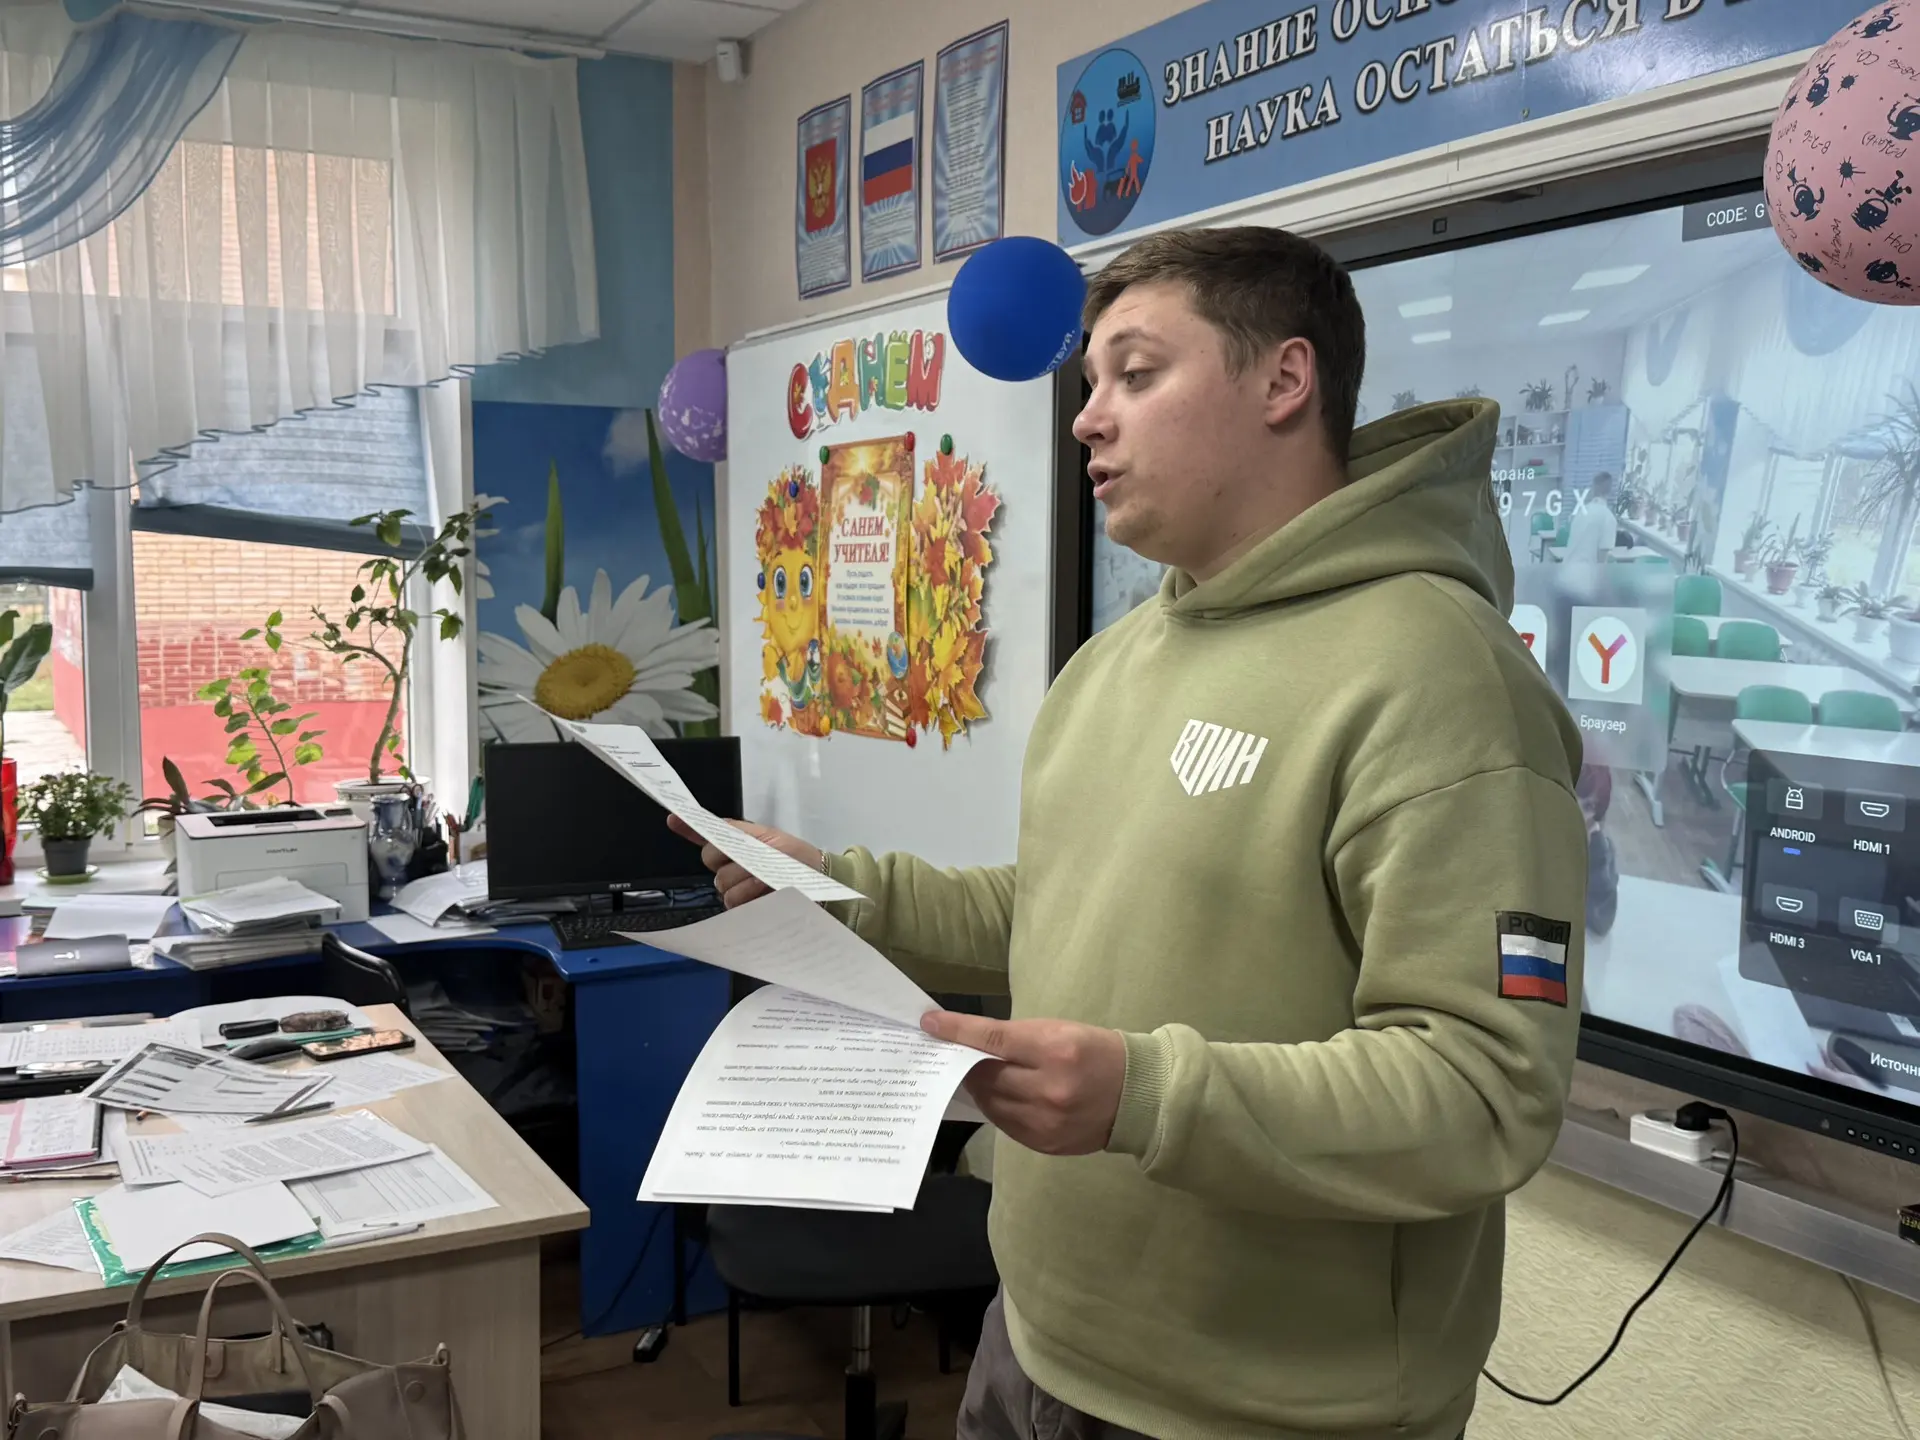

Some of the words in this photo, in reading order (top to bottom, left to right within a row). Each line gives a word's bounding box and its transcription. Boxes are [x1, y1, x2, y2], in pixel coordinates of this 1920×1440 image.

[1164, 6, 1317, 106] ЗНАНИЕ
[1204, 76, 1341, 163] НАУКА
[1355, 0, 1642, 112] ОСТАТЬСЯ
[1707, 206, 1748, 227] CODE:
[834, 543, 890, 563] УЧИТЕЛЯ!
[1580, 715, 1627, 733] Браузер
[1170, 719, 1268, 796] ВОИН
[1770, 827, 1816, 843] ANDROID
[1853, 839, 1882, 854] HDMI
[1885, 844, 1890, 854] 1
[1770, 932, 1797, 947] HDMI
[1798, 938, 1805, 948] 3
[1851, 949, 1873, 963] VGA
[1876, 954, 1881, 965] 1
